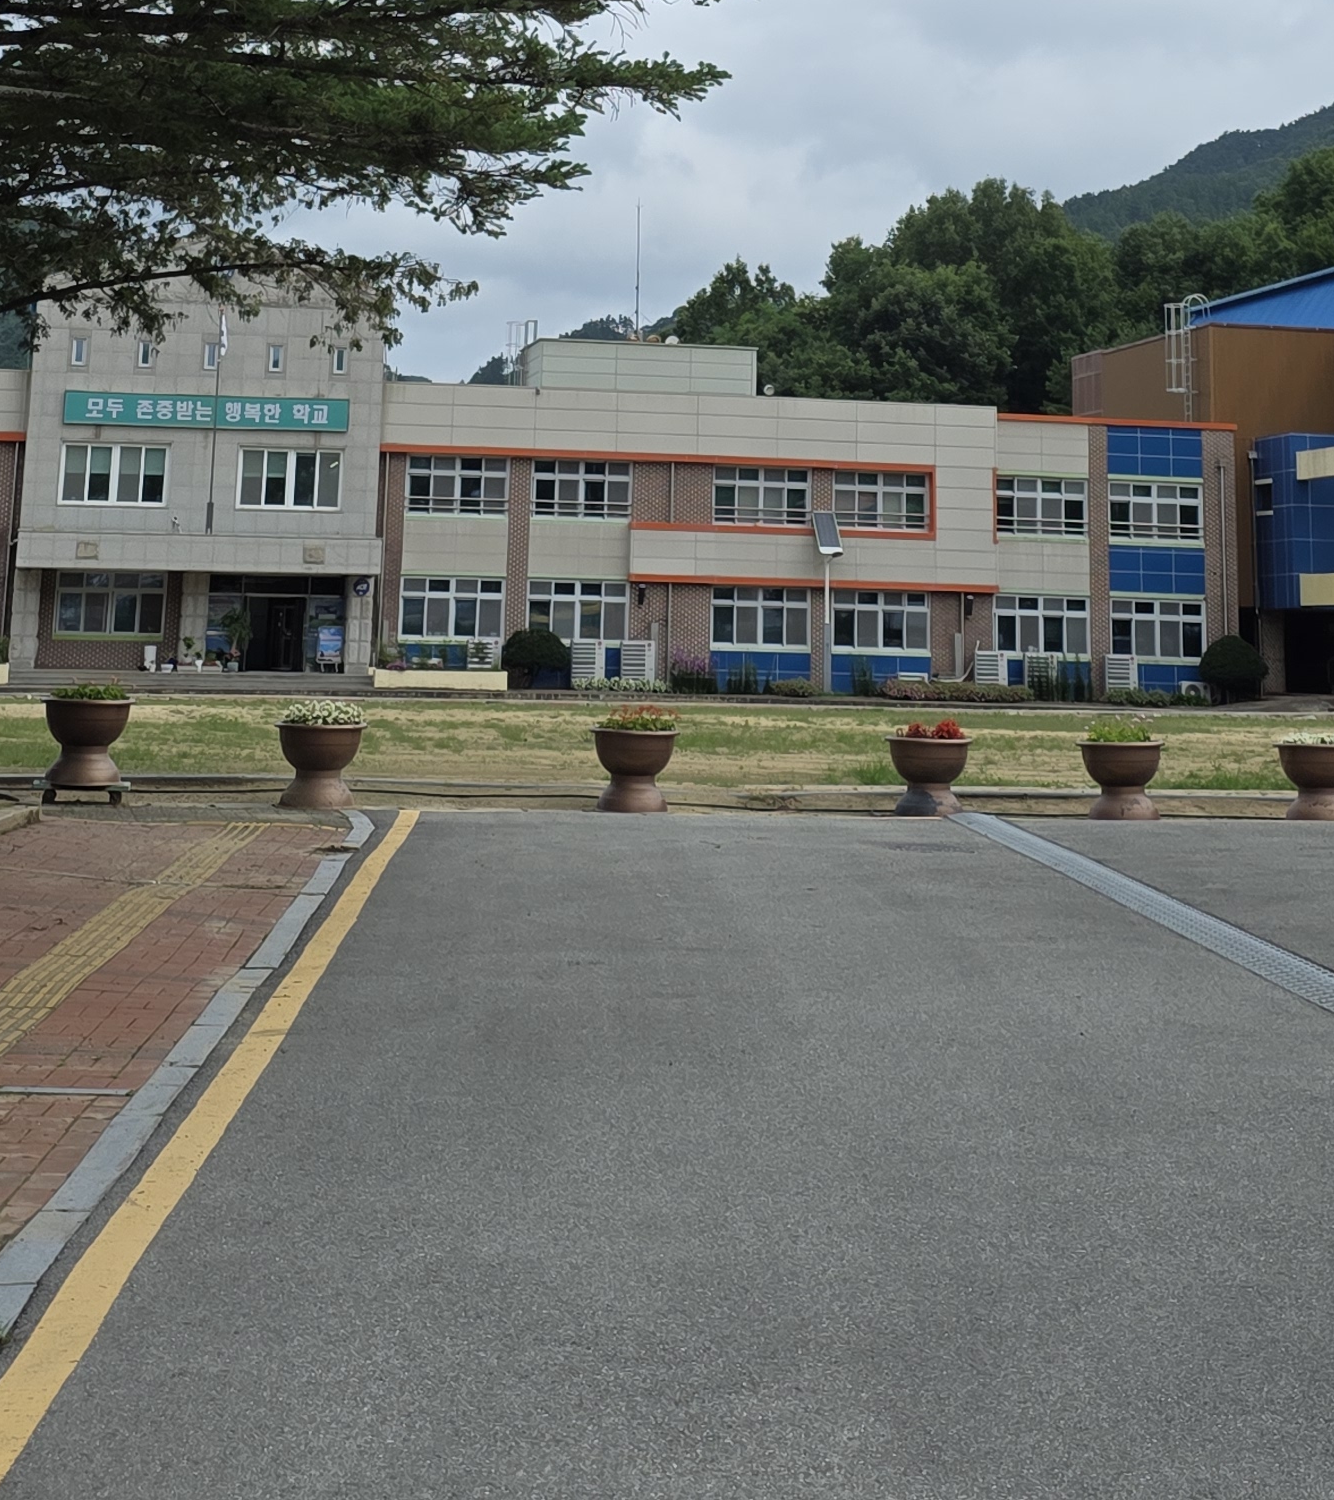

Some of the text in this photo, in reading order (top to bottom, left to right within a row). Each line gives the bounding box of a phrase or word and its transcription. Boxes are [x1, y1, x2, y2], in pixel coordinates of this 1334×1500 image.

[85, 397, 124, 419] 모두
[225, 401, 282, 424] 행복한
[292, 403, 329, 425] 학교
